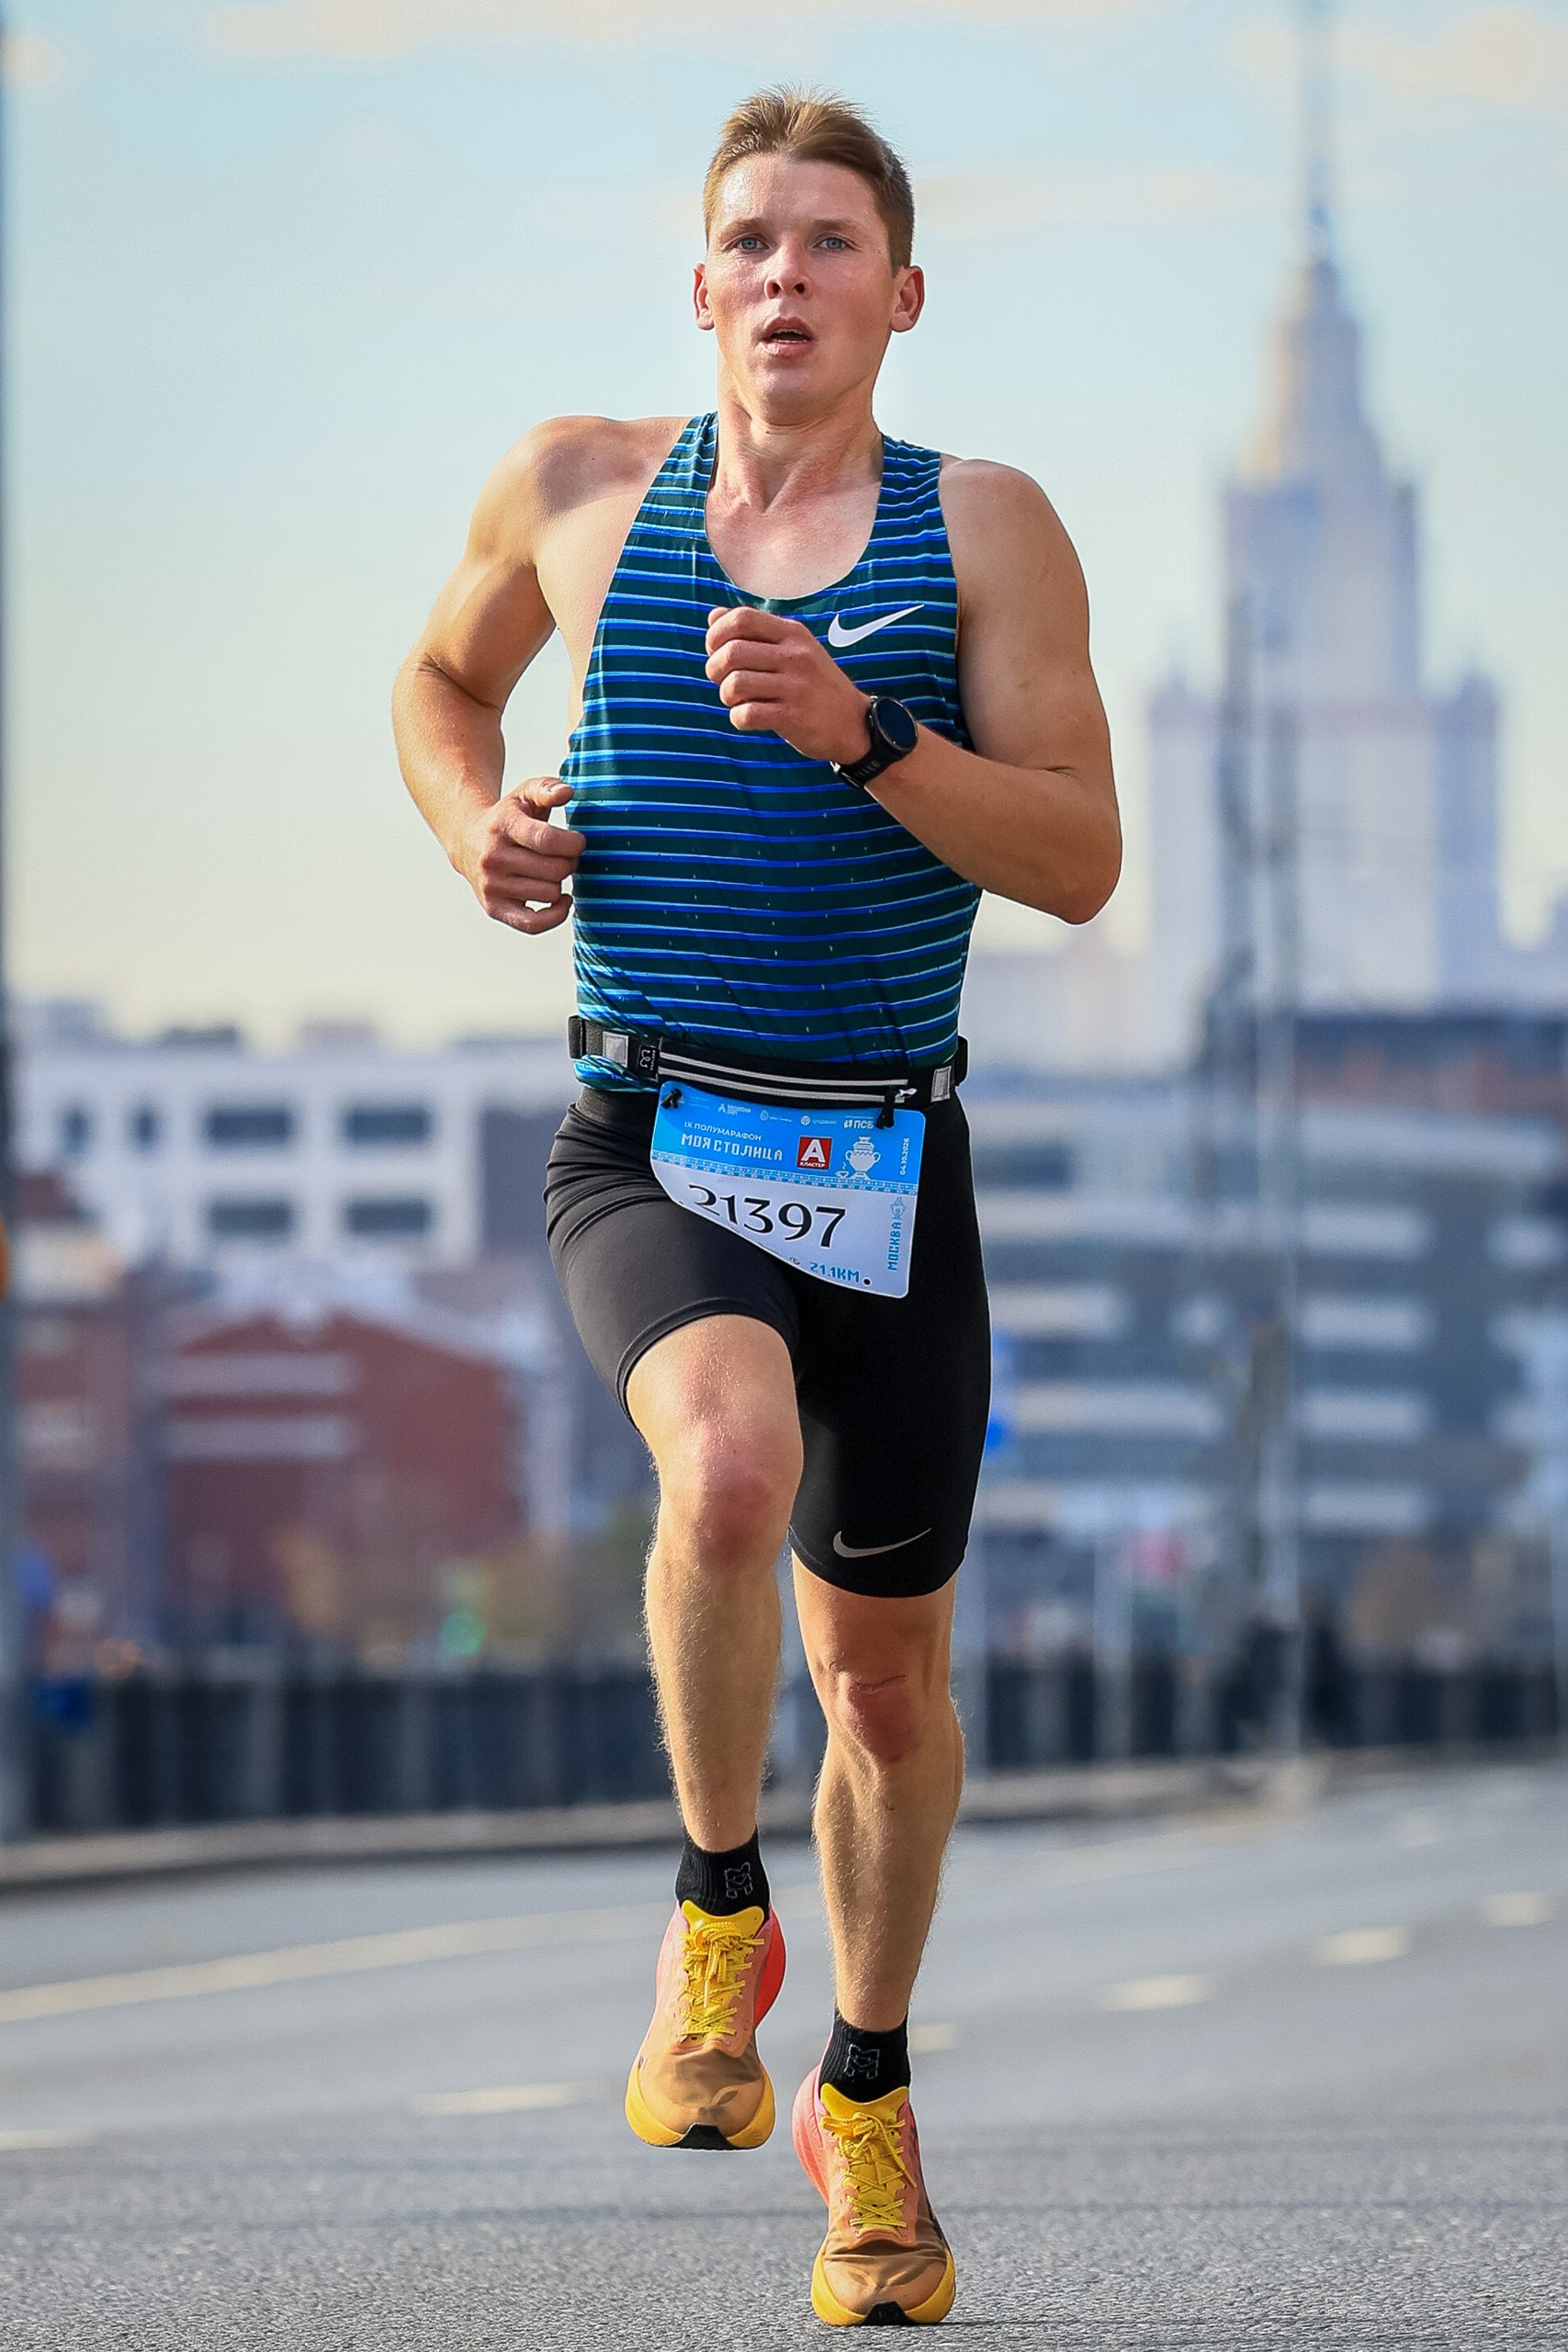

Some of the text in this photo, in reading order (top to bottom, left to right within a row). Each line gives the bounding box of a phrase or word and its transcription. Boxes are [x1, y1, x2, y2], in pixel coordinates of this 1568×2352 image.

[681, 1133, 784, 1161] МОЯ СТОЛИЦА
[694, 1123, 762, 1141] ПОЛУМАРАФОН
[689, 1184, 846, 1249] 21397
[887, 1221, 902, 1272] МОСКВА
